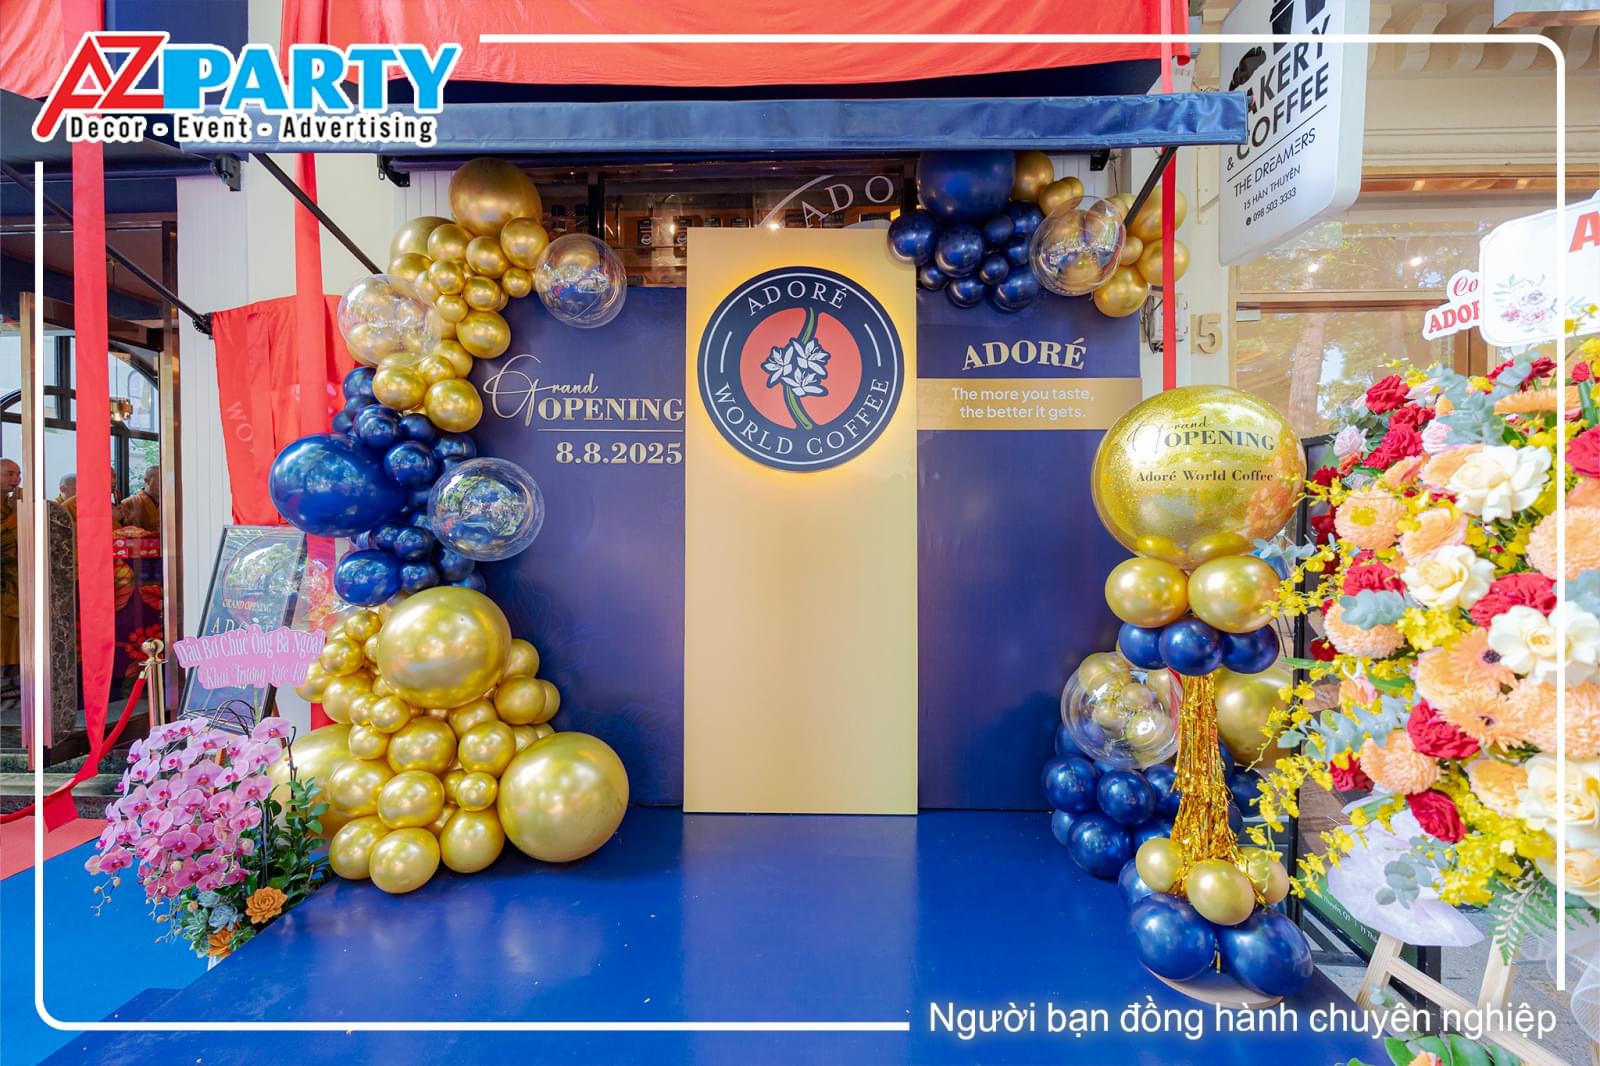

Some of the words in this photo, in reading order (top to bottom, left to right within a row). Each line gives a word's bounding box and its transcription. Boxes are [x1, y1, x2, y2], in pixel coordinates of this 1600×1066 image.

[1246, 14, 1331, 115] AKERY
[1233, 174, 1252, 198] THE
[1254, 127, 1316, 184] DREAMERS
[749, 280, 847, 317] ADORÉ
[962, 337, 1087, 371] ADORÉ
[483, 354, 598, 426] Grand
[951, 387, 977, 401] The
[980, 389, 1018, 401] more
[1021, 389, 1049, 403] you
[1052, 388, 1095, 402] taste,
[537, 397, 685, 422] OPENING
[714, 381, 793, 455] WORLD
[807, 378, 889, 455] COFFEE
[959, 406, 984, 418] the
[986, 406, 1033, 418] better
[1035, 406, 1046, 418] it
[1048, 407, 1086, 420] gets.
[555, 441, 683, 465] 8.8.2025
[1164, 430, 1275, 451] OPENING
[1136, 470, 1176, 482] Adoré
[1183, 470, 1226, 482] World
[1231, 469, 1273, 482] Coffee
